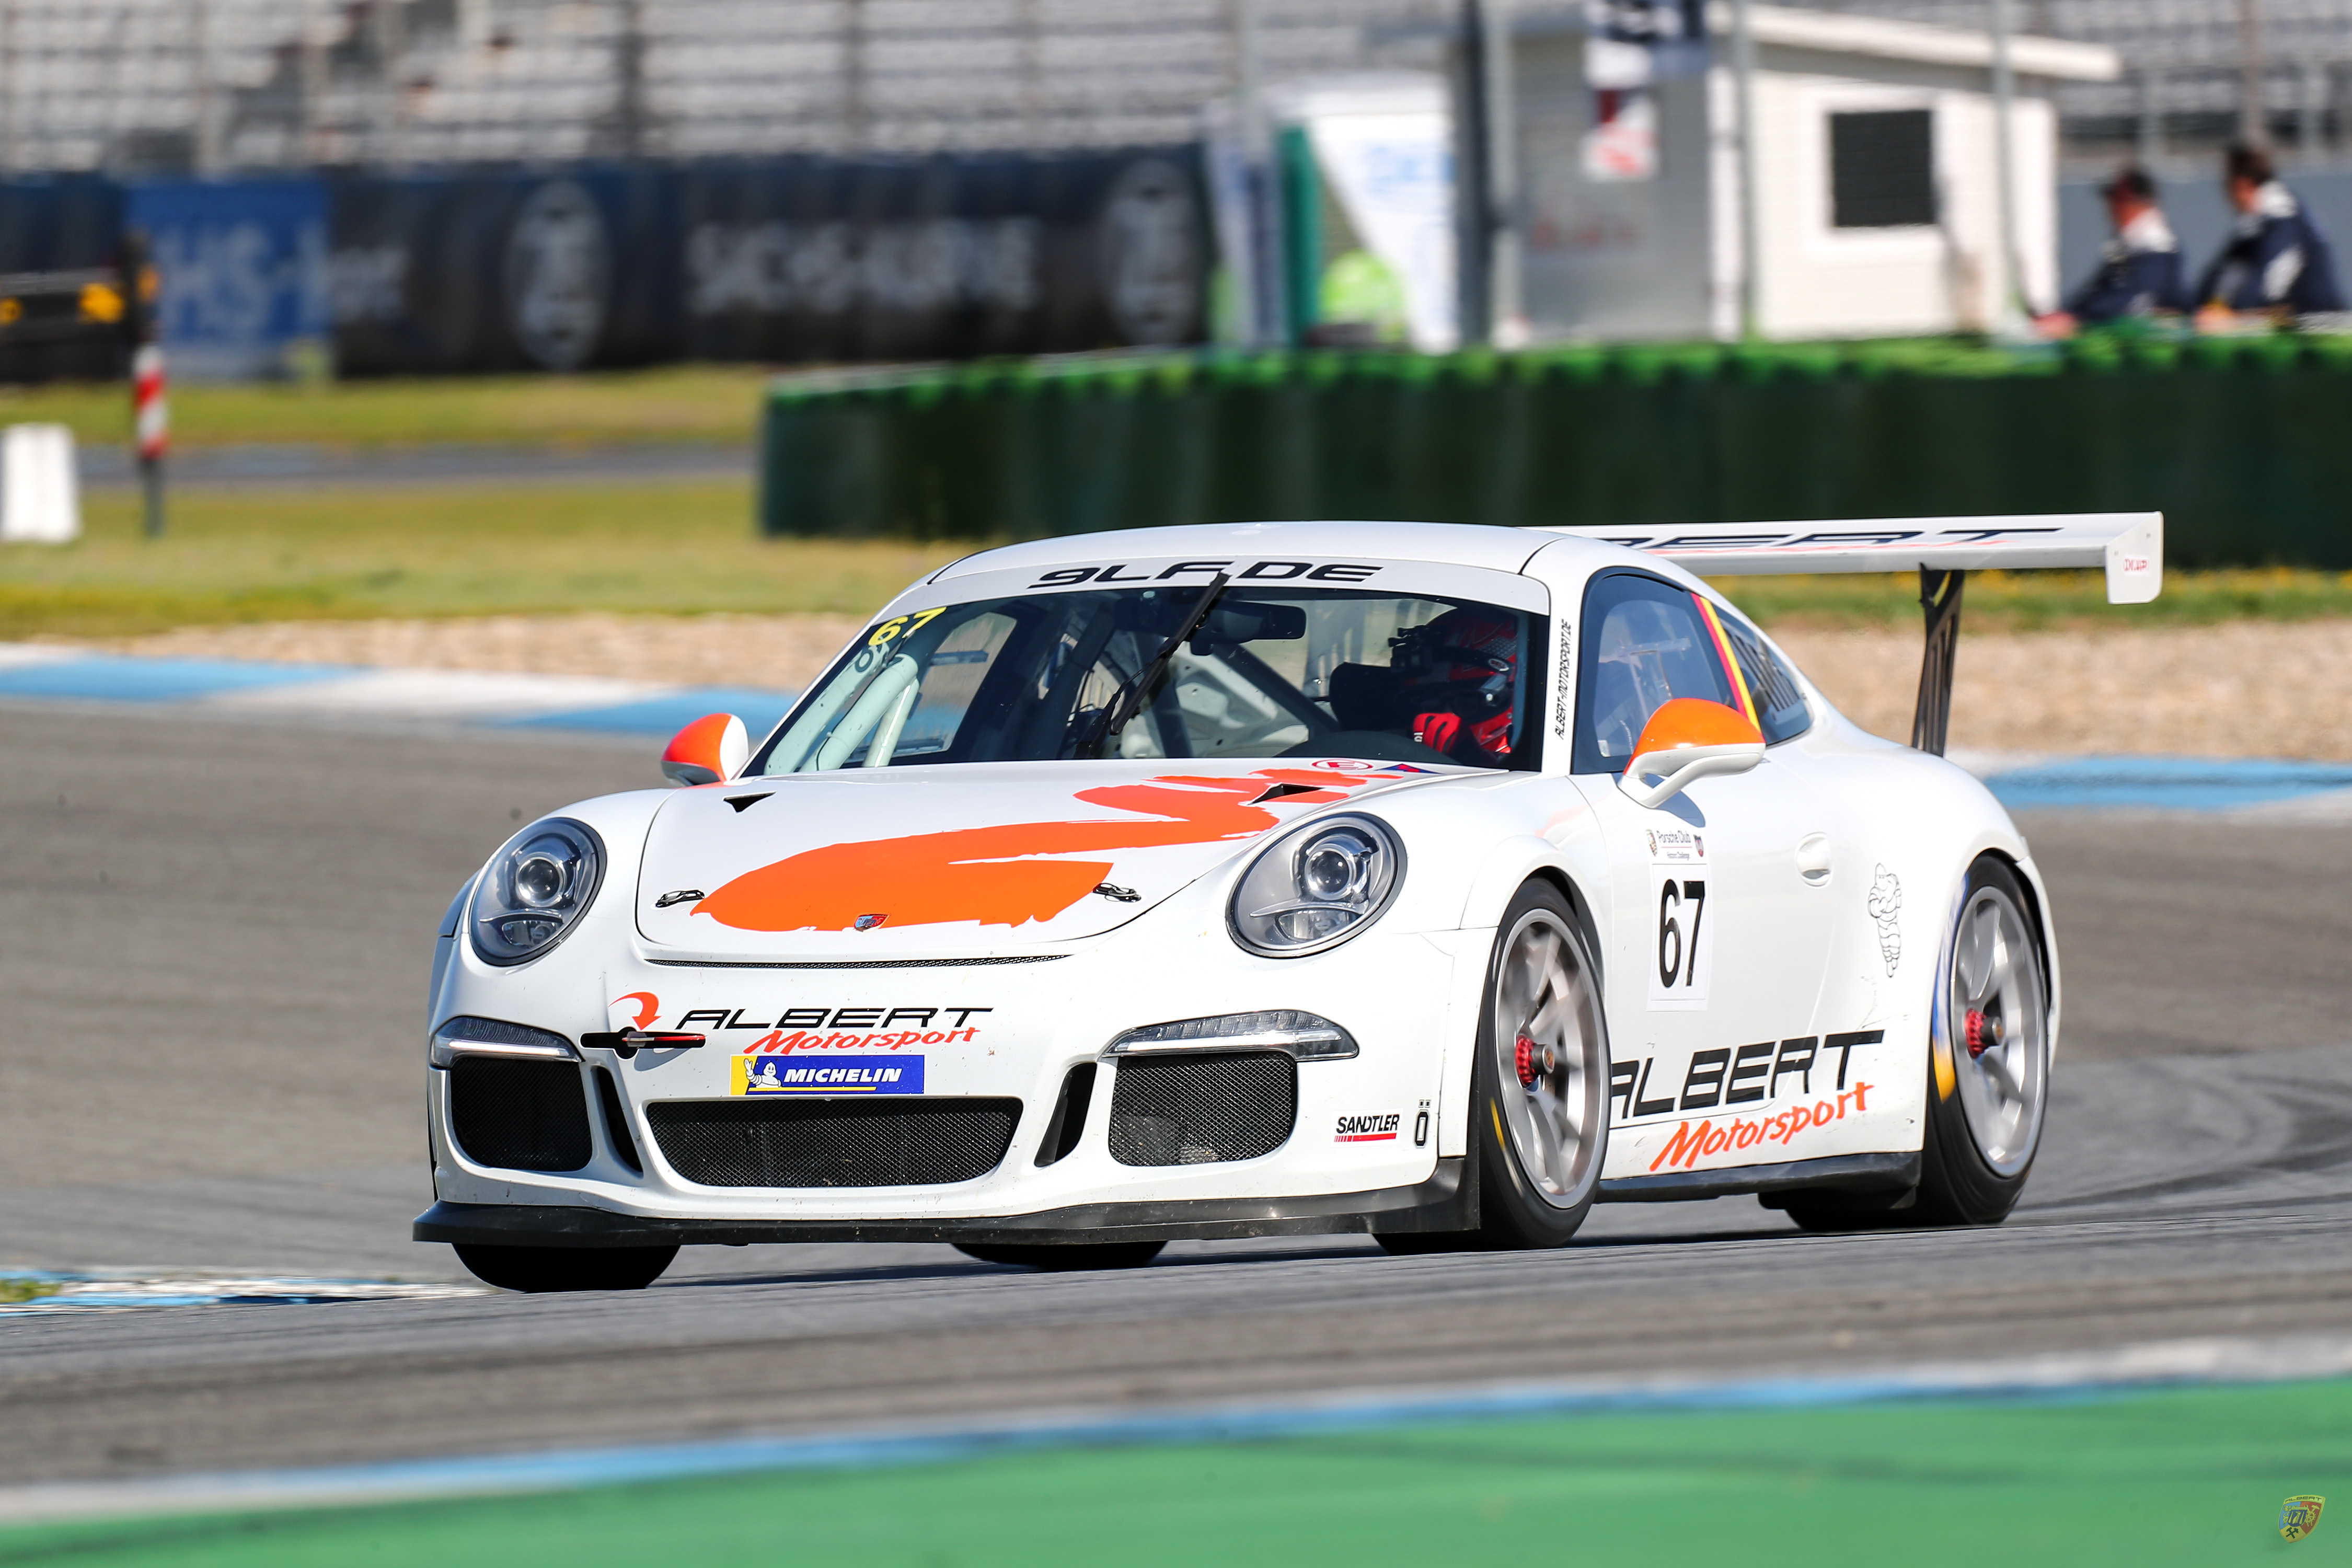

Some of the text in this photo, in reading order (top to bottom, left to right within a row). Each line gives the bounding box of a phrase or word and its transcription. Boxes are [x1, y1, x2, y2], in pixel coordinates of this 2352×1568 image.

[868, 607, 947, 646] 67
[1656, 831, 1691, 843] Porsche Club
[1659, 879, 1705, 988] 67
[675, 1008, 994, 1030] ALBERT
[743, 1026, 981, 1055] Motorsport
[783, 1068, 903, 1083] MICHELIN
[1611, 1030, 1885, 1119] ALBERT
[1336, 1114, 1400, 1134] SANDTLER
[1650, 1082, 1875, 1172] Motorsport
